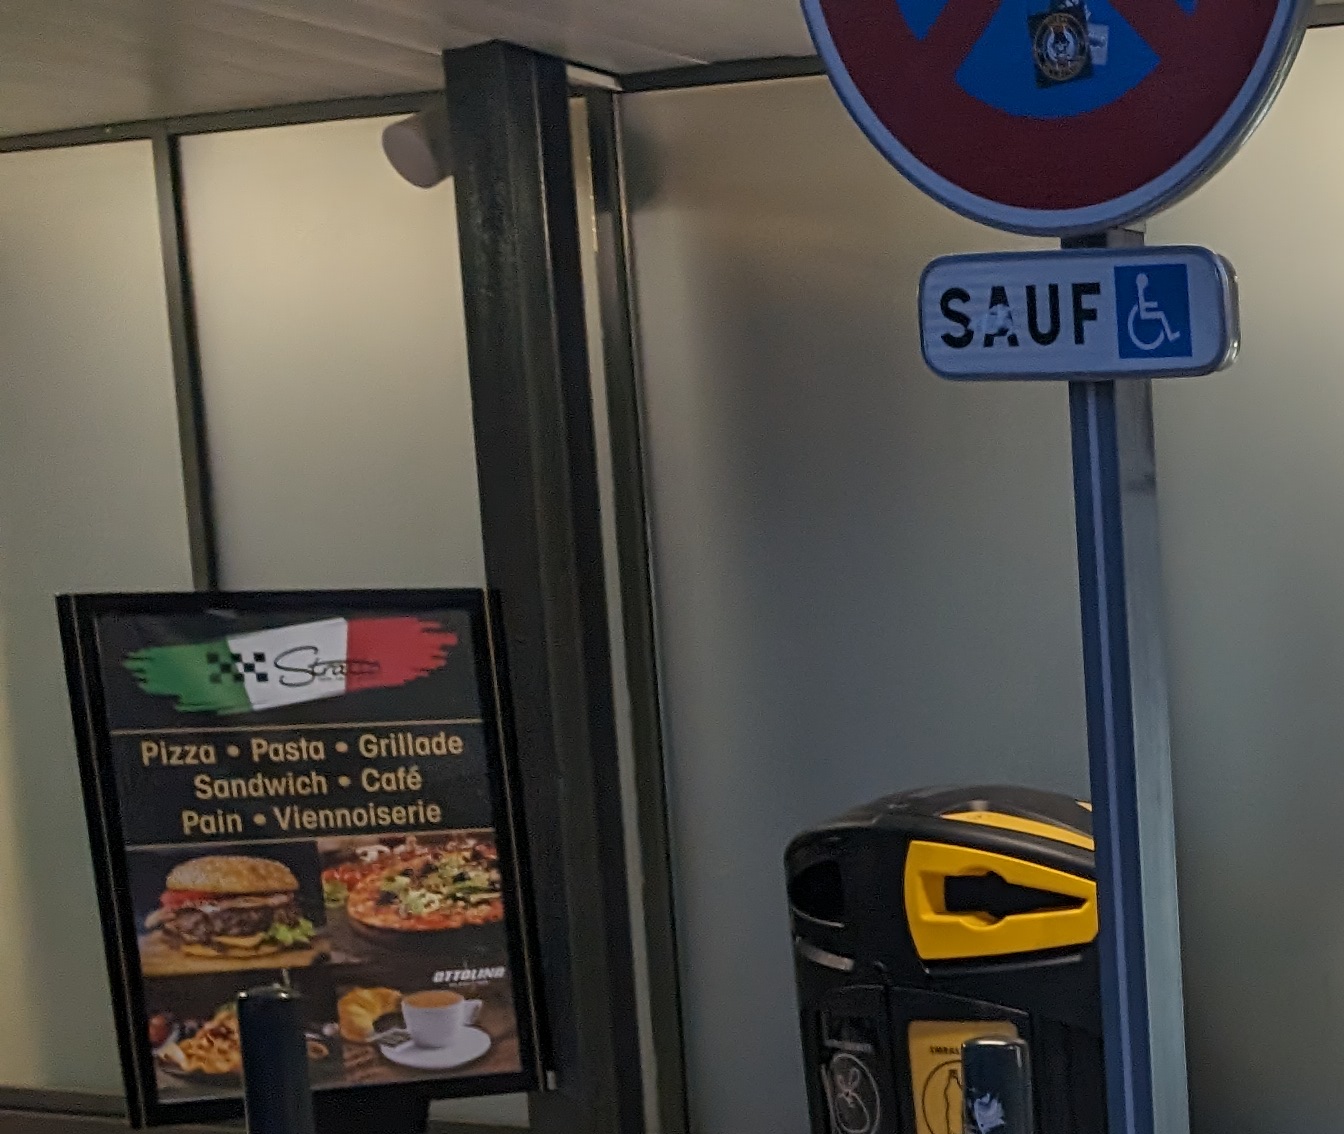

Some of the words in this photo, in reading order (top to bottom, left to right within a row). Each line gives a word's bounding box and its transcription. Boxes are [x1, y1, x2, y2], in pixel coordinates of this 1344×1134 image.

[940, 282, 1101, 349] SAUF
[141, 738, 216, 767] Pizza
[251, 736, 325, 763] Pasta
[358, 730, 464, 759] Grillade
[194, 769, 328, 800] Sandwich
[360, 763, 422, 793] Café
[181, 808, 243, 836] Pain
[273, 801, 443, 832] Viennoiserie
